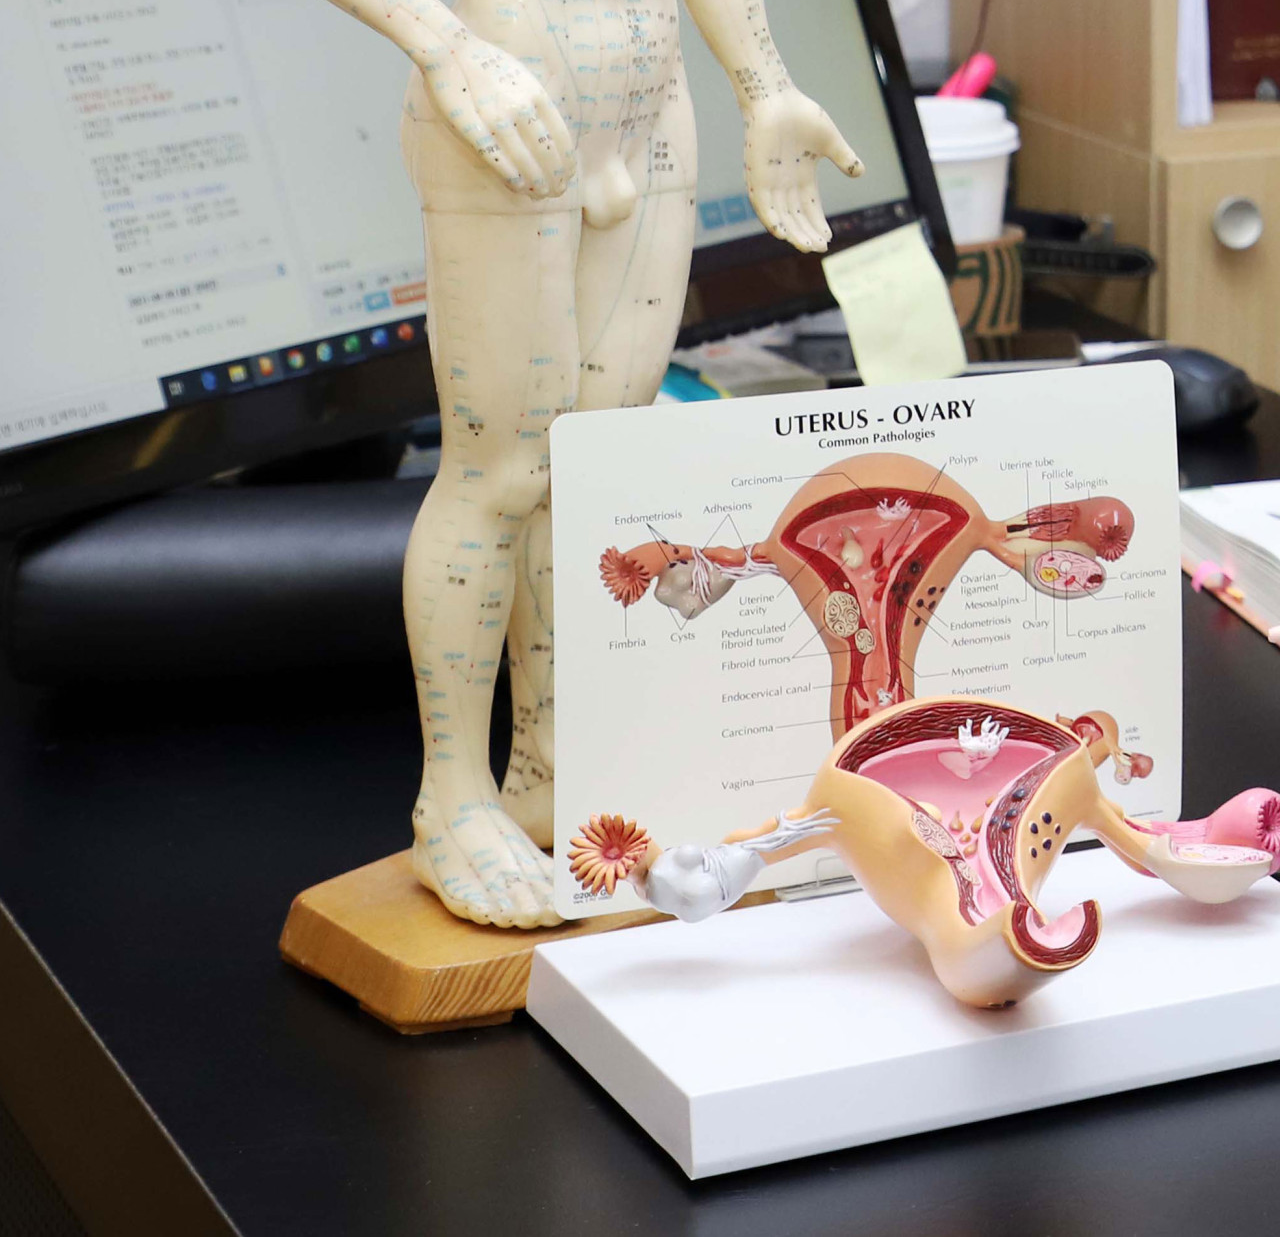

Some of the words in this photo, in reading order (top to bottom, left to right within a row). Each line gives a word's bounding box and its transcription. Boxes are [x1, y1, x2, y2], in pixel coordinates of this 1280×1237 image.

[775, 409, 869, 436] UTERUS
[893, 398, 976, 425] OVARY
[818, 435, 869, 449] Common
[872, 428, 936, 447] Pathologies
[949, 454, 978, 466] Polyps
[1000, 460, 1033, 471] Uterine
[1035, 457, 1055, 469] tube
[731, 474, 783, 488] Carcinoma
[1041, 469, 1074, 480] Follicle
[1064, 478, 1109, 491] Salpingitis
[703, 502, 753, 514] Adhesions
[614, 511, 683, 526] Endometriosis
[960, 572, 997, 584] Ovarian
[1120, 567, 1167, 581] Carcinoma
[961, 583, 999, 597] ligament
[1124, 589, 1156, 601] Follicle
[739, 594, 775, 606] Uterine
[965, 596, 1020, 610] Mesosalpinx
[739, 607, 767, 618] cavity
[950, 616, 1011, 631] Endometriosis
[1022, 619, 1050, 631] Ovary
[1078, 627, 1109, 640] Corpus
[1111, 621, 1146, 635] albicans
[670, 630, 696, 644] Cysts
[721, 623, 786, 639] Pedunculated
[609, 637, 646, 650] Fimbria
[721, 638, 754, 650] fibroid
[756, 635, 784, 646] tumor
[951, 632, 1011, 648] Adenomyosis
[721, 658, 756, 671] Fibroid
[759, 655, 791, 666] tumors
[1022, 655, 1054, 669] Corpus
[1056, 650, 1087, 663] luteum
[951, 661, 1009, 677] Myometrium
[722, 687, 783, 703] Endocervical
[786, 683, 811, 694] canal
[721, 724, 774, 738] Carcinoma
[721, 779, 755, 791] Vagina
